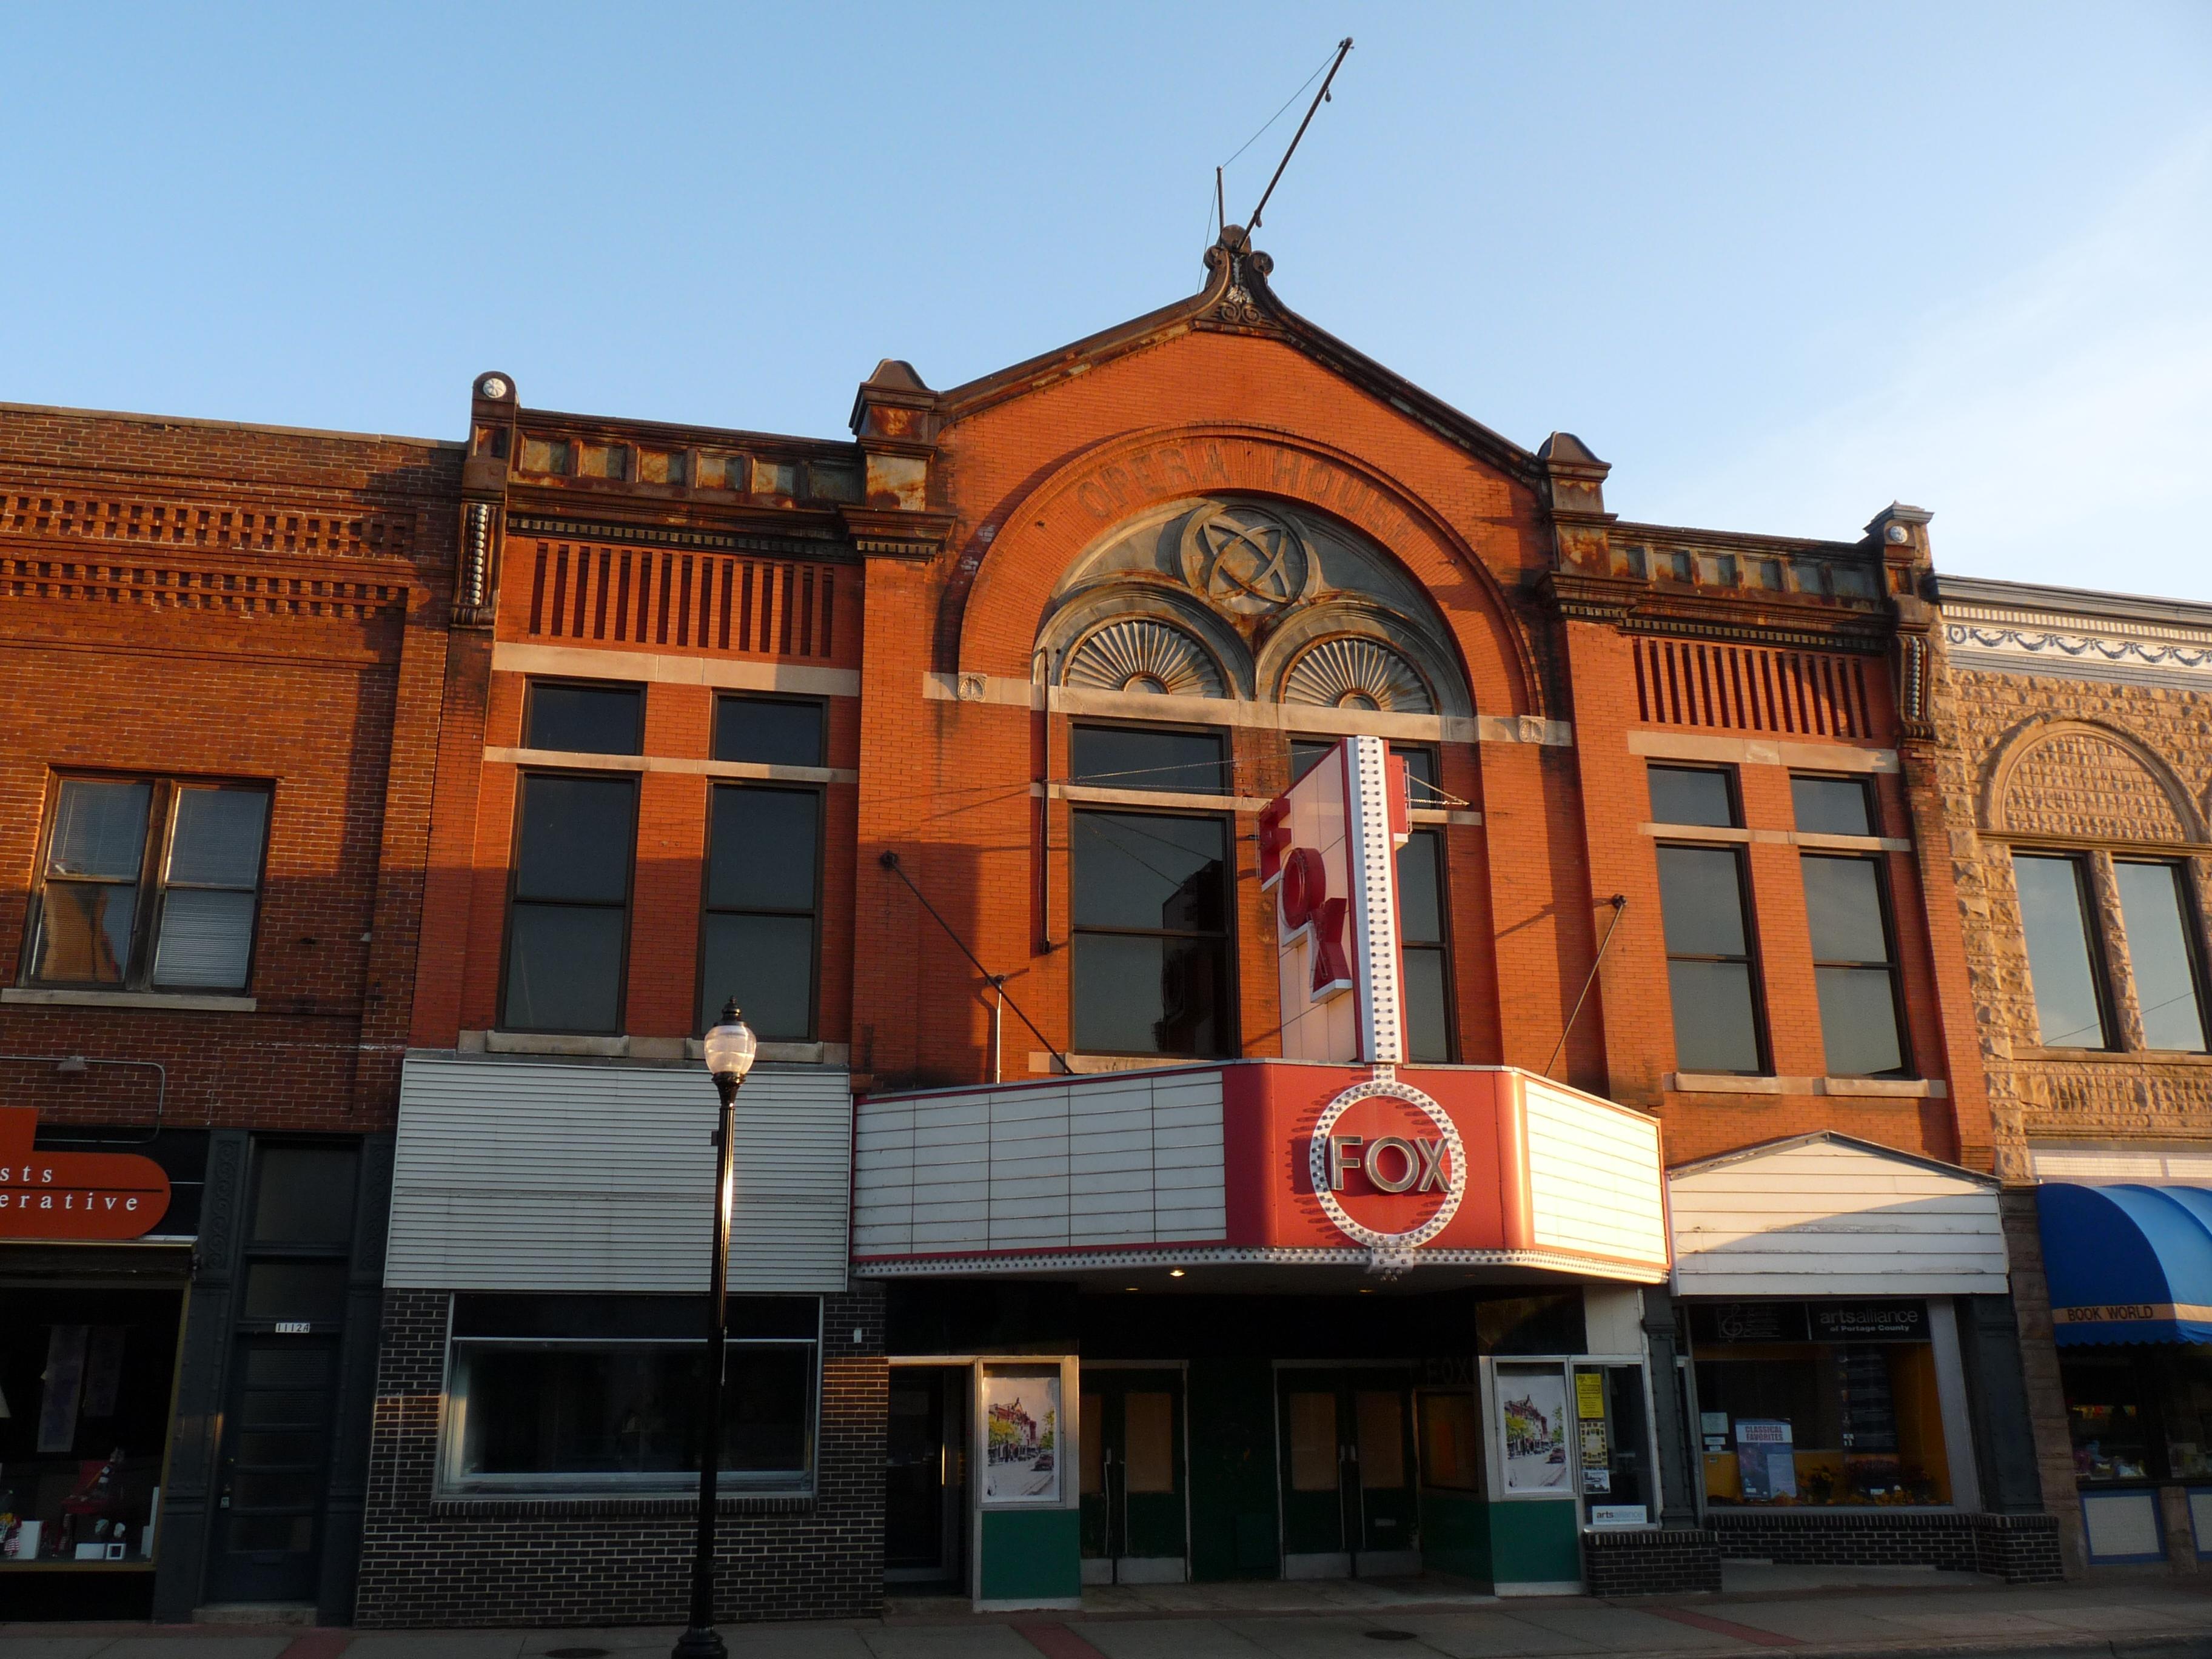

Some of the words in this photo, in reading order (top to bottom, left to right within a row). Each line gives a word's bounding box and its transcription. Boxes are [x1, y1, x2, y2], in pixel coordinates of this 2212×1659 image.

[1077, 438, 1232, 517] OPERA
[1273, 447, 1409, 552] HOUSE
[1259, 797, 1353, 1003] FOX
[1330, 1134, 1452, 1193] FOX
[278, 1323, 309, 1332] 1112A
[1819, 1309, 1918, 1324] artsalliance
[2067, 1307, 2103, 1321] BOOK
[2106, 1305, 2154, 1319] WORLD
